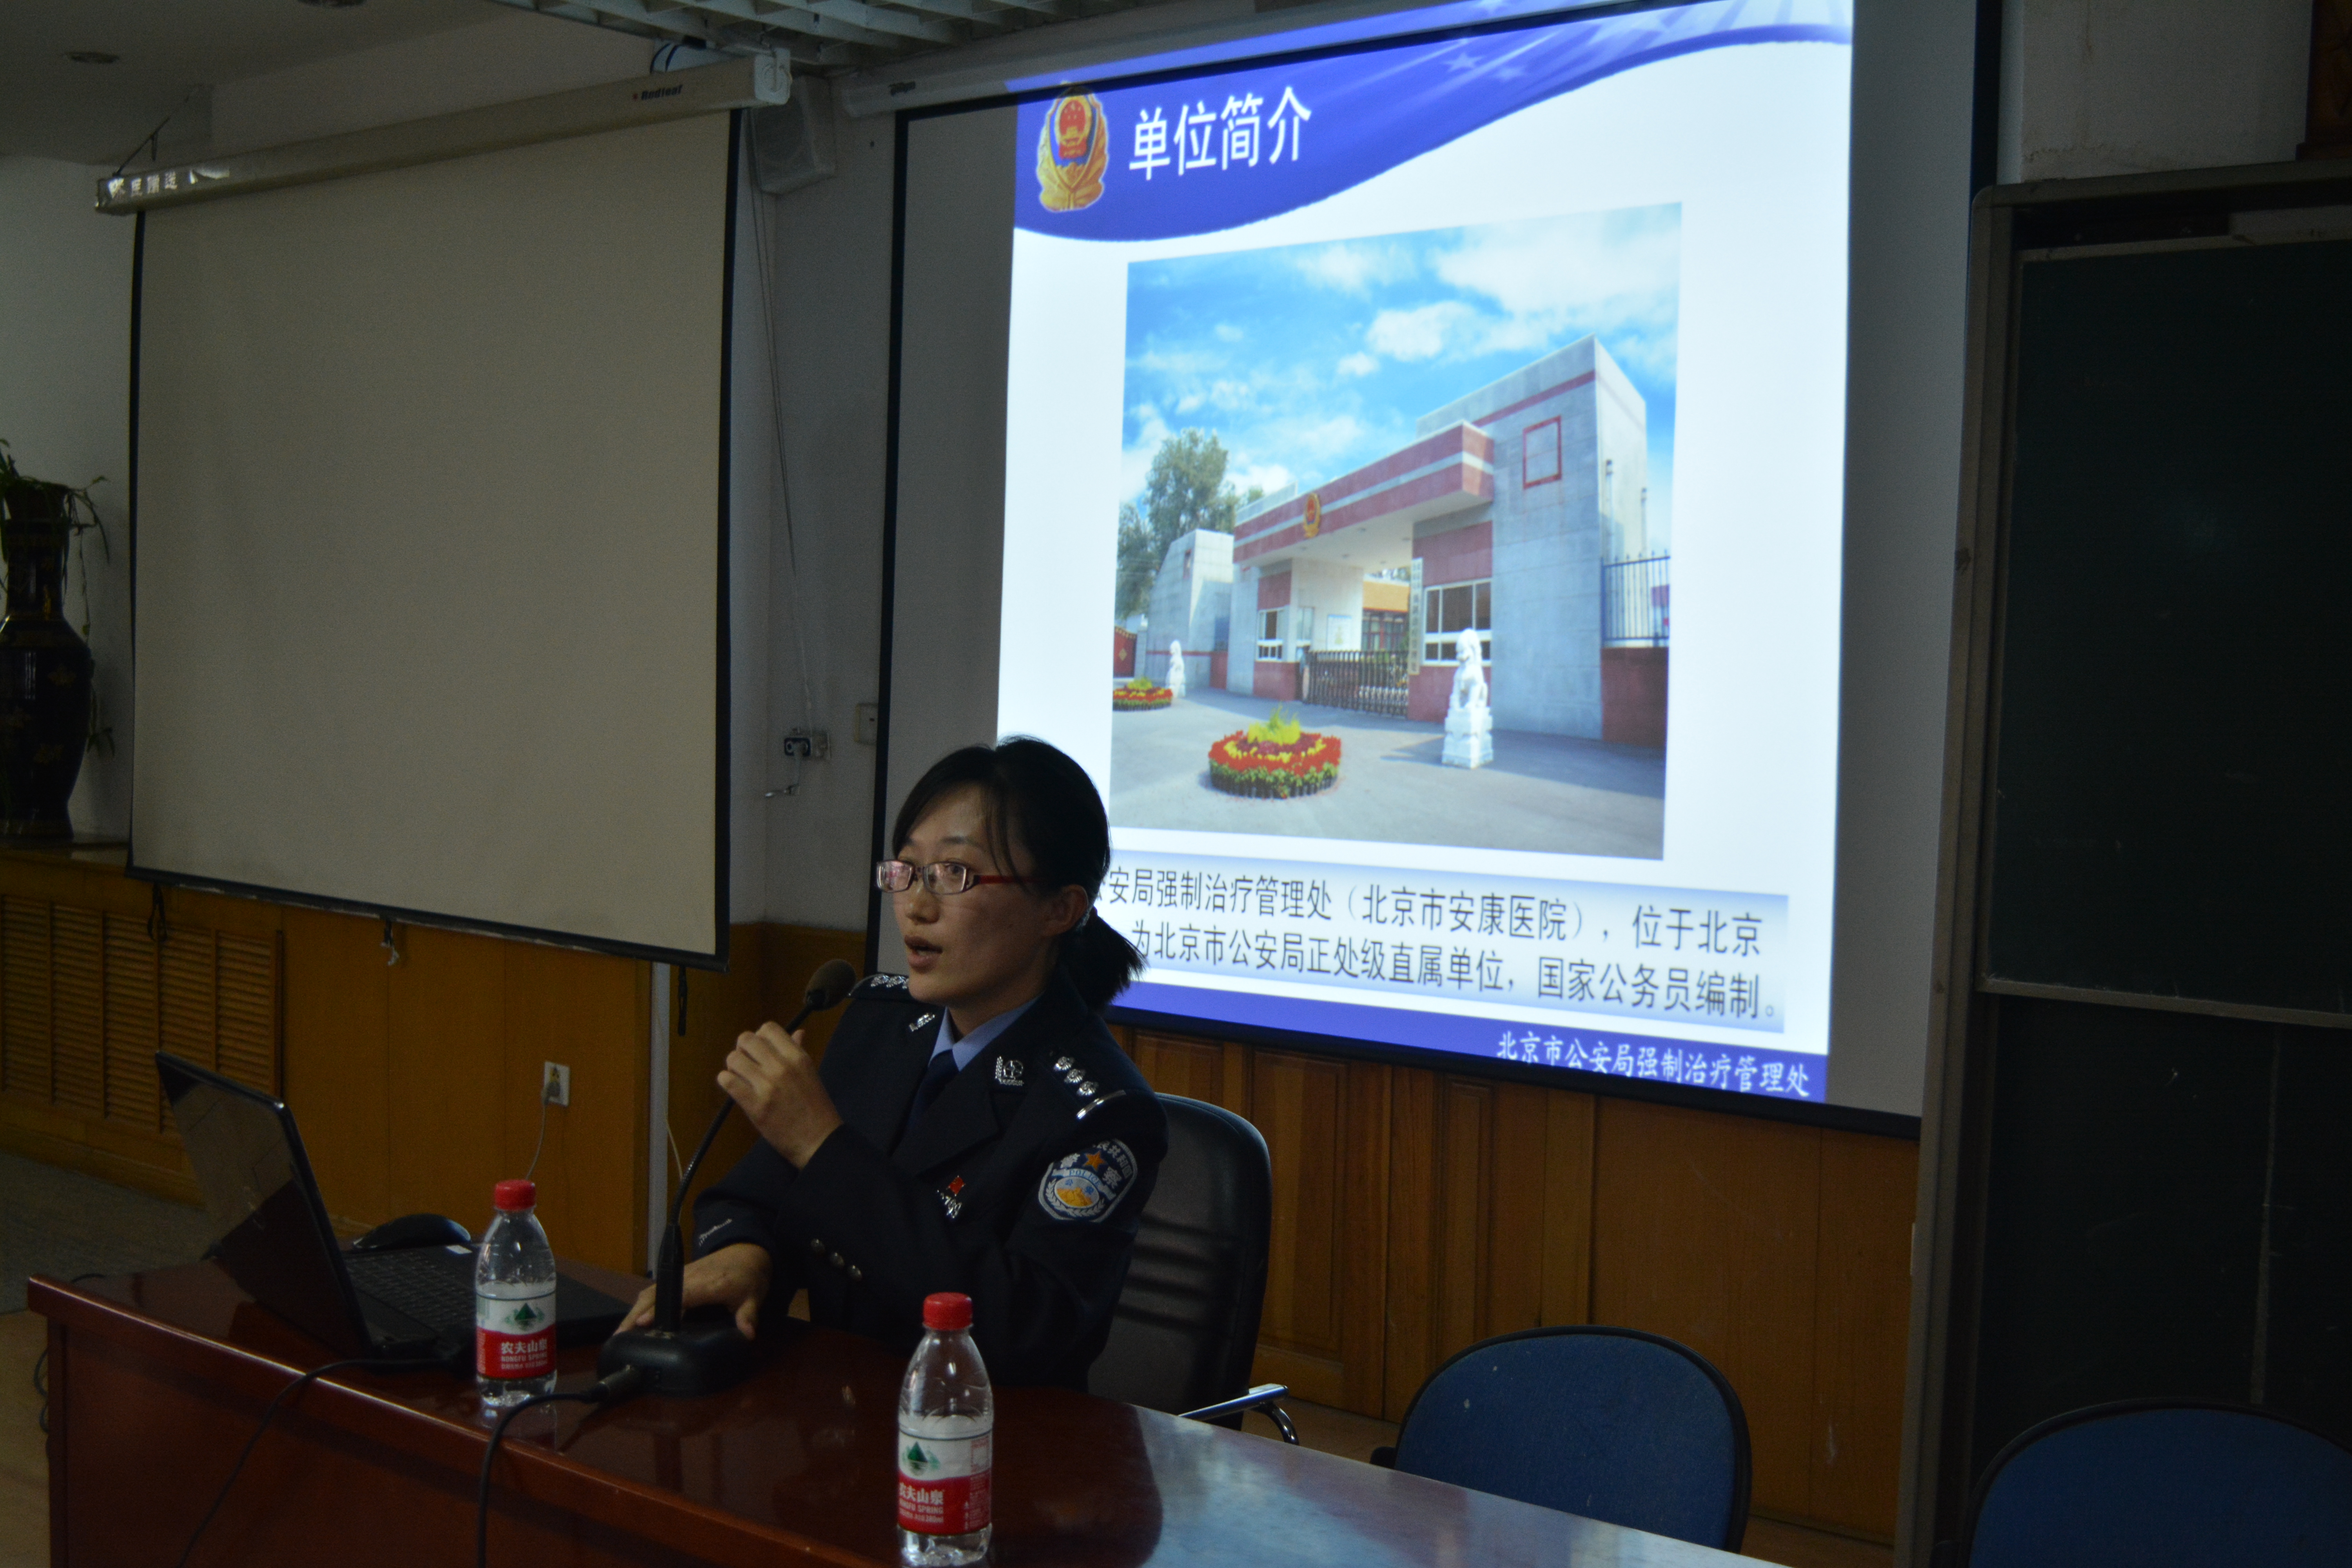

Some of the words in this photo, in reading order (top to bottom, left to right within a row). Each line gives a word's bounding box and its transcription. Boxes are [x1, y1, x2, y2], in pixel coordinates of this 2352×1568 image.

[1129, 85, 1312, 181] 单位简介
[1496, 1031, 1809, 1097] 北京市公安局强制治疗管理处
[1069, 1169, 1101, 1186] POLICE
[917, 1504, 944, 1514] SPRING
